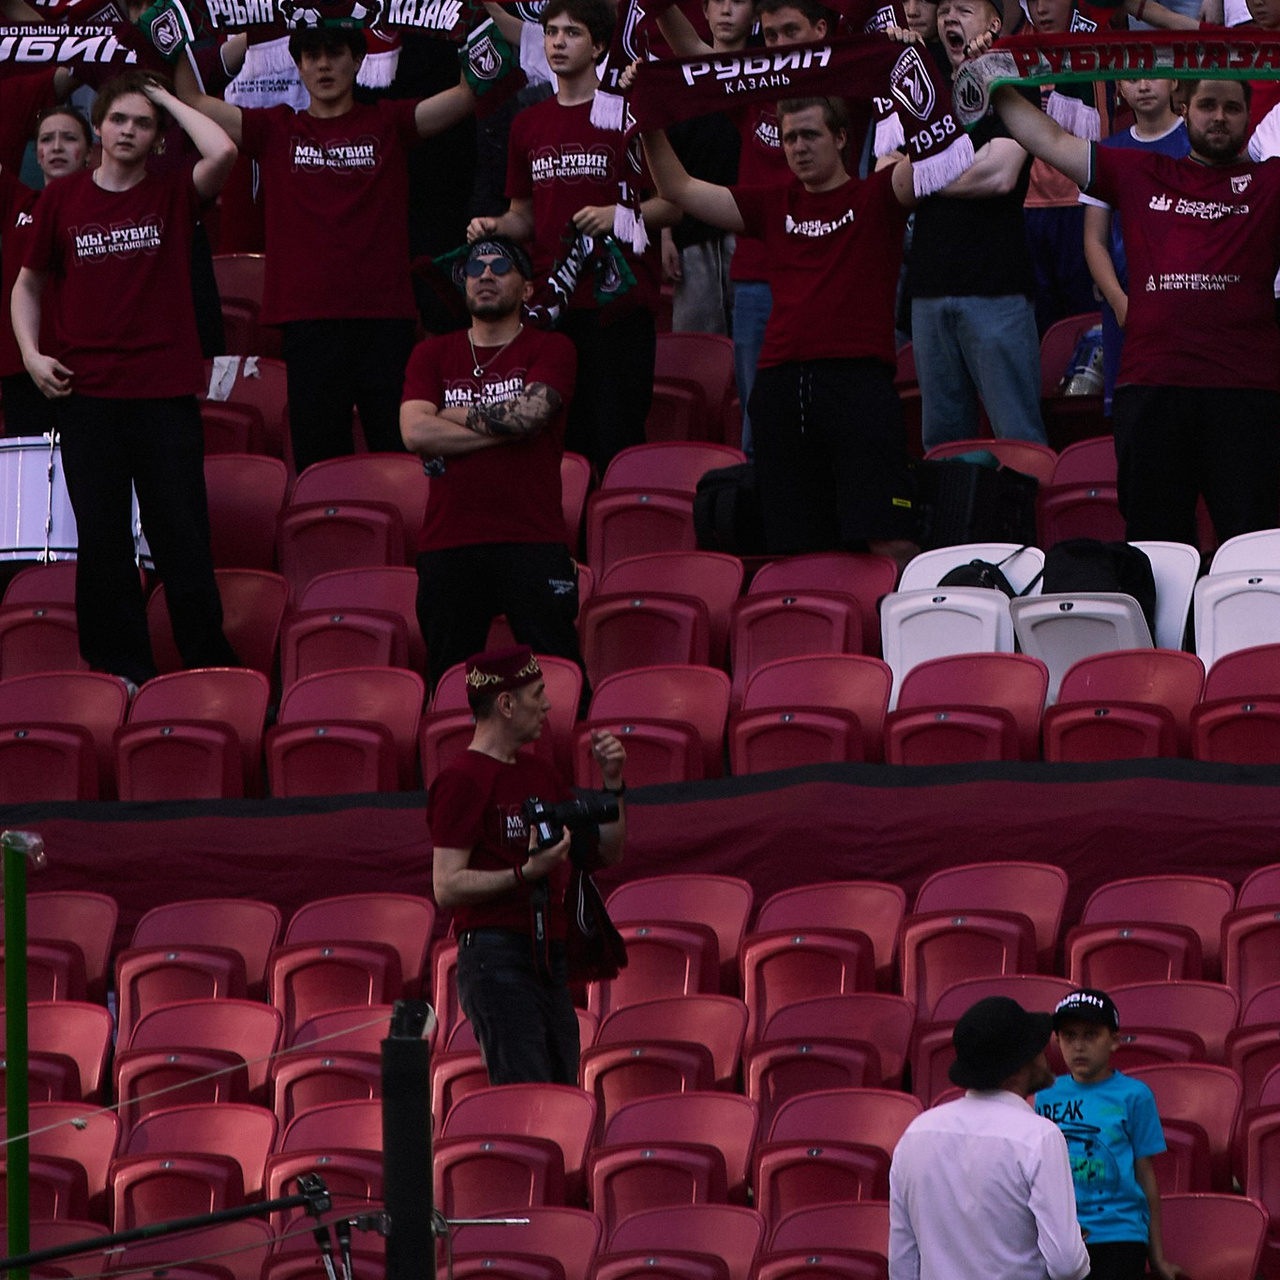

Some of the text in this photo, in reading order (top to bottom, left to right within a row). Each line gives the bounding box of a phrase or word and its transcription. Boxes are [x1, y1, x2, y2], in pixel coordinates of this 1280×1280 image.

[0, 23, 115, 36] БОЛЬНЫЙ КЛУБ
[680, 45, 832, 87] РУБИН
[1011, 41, 1157, 79] РУБИН
[724, 74, 791, 94] КАЗАНЬ
[909, 113, 957, 154] 1958
[1159, 273, 1241, 283] НИЖНЕКАМСК
[1159, 281, 1226, 292] НЕФТЕХИМ
